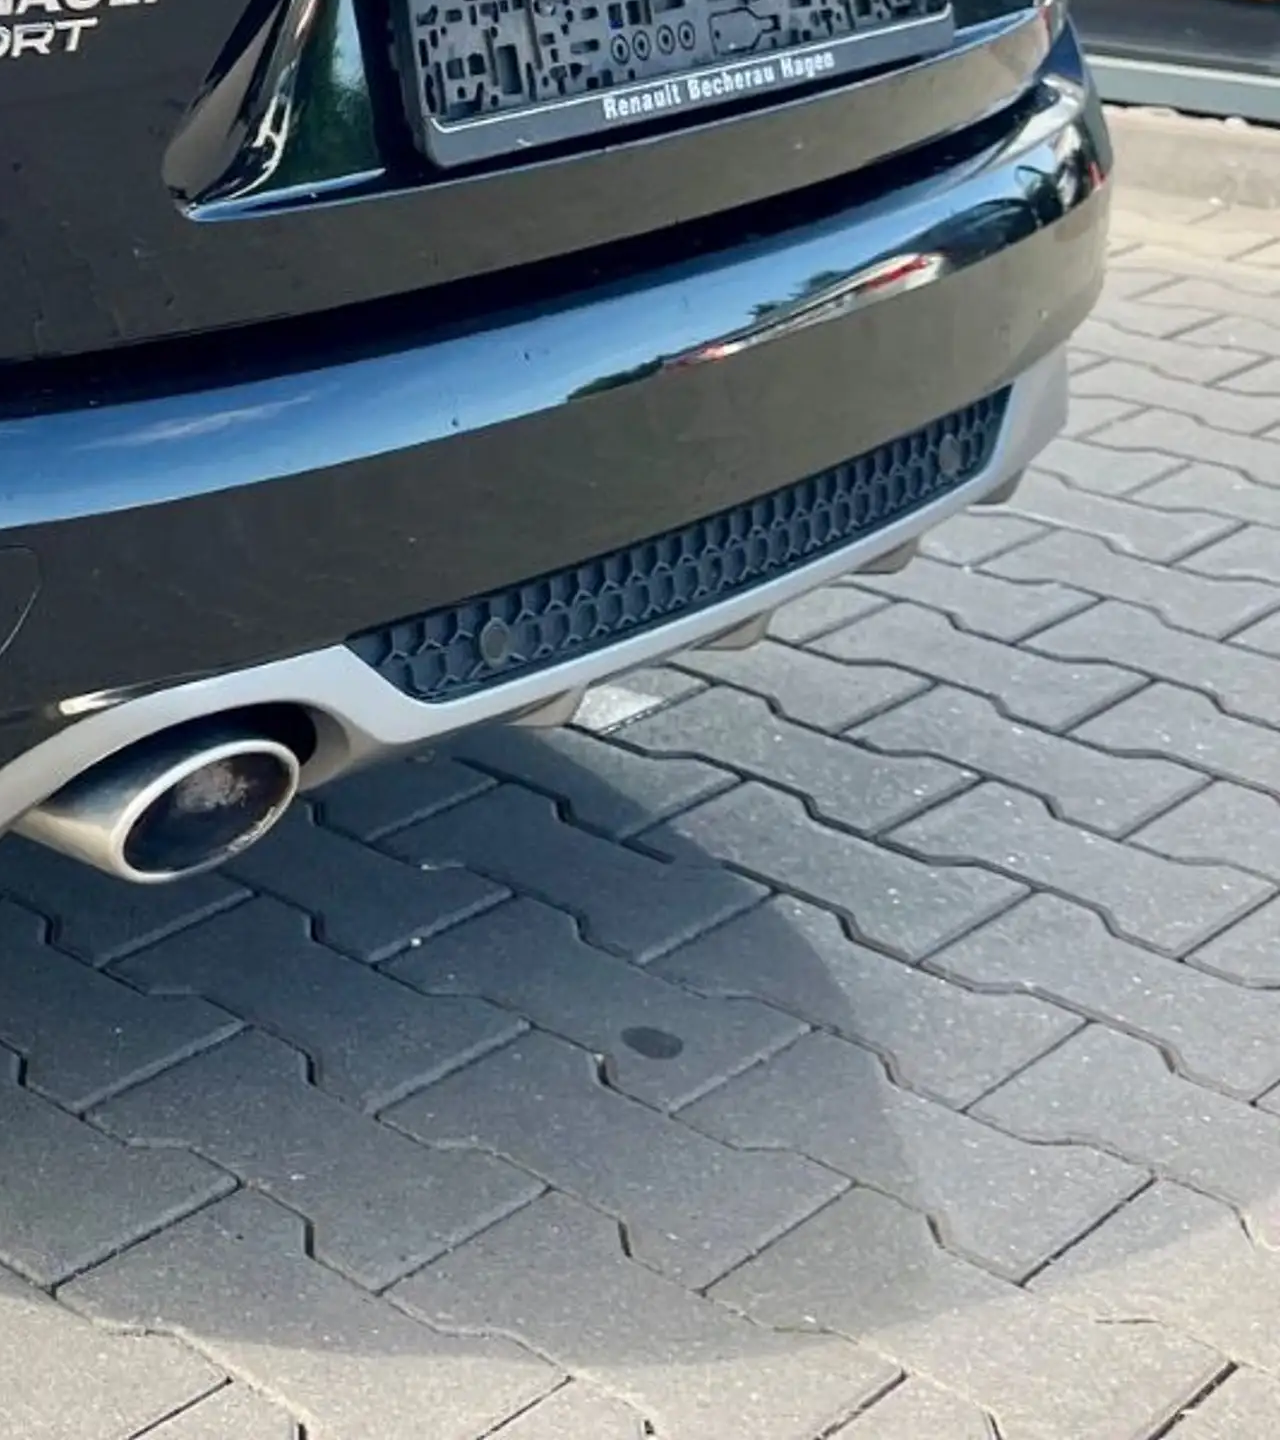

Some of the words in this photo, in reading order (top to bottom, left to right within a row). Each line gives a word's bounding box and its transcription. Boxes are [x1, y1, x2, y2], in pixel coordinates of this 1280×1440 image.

[602, 83, 682, 120] Renault
[688, 65, 775, 99] Becherau
[780, 50, 836, 78] Hagen
